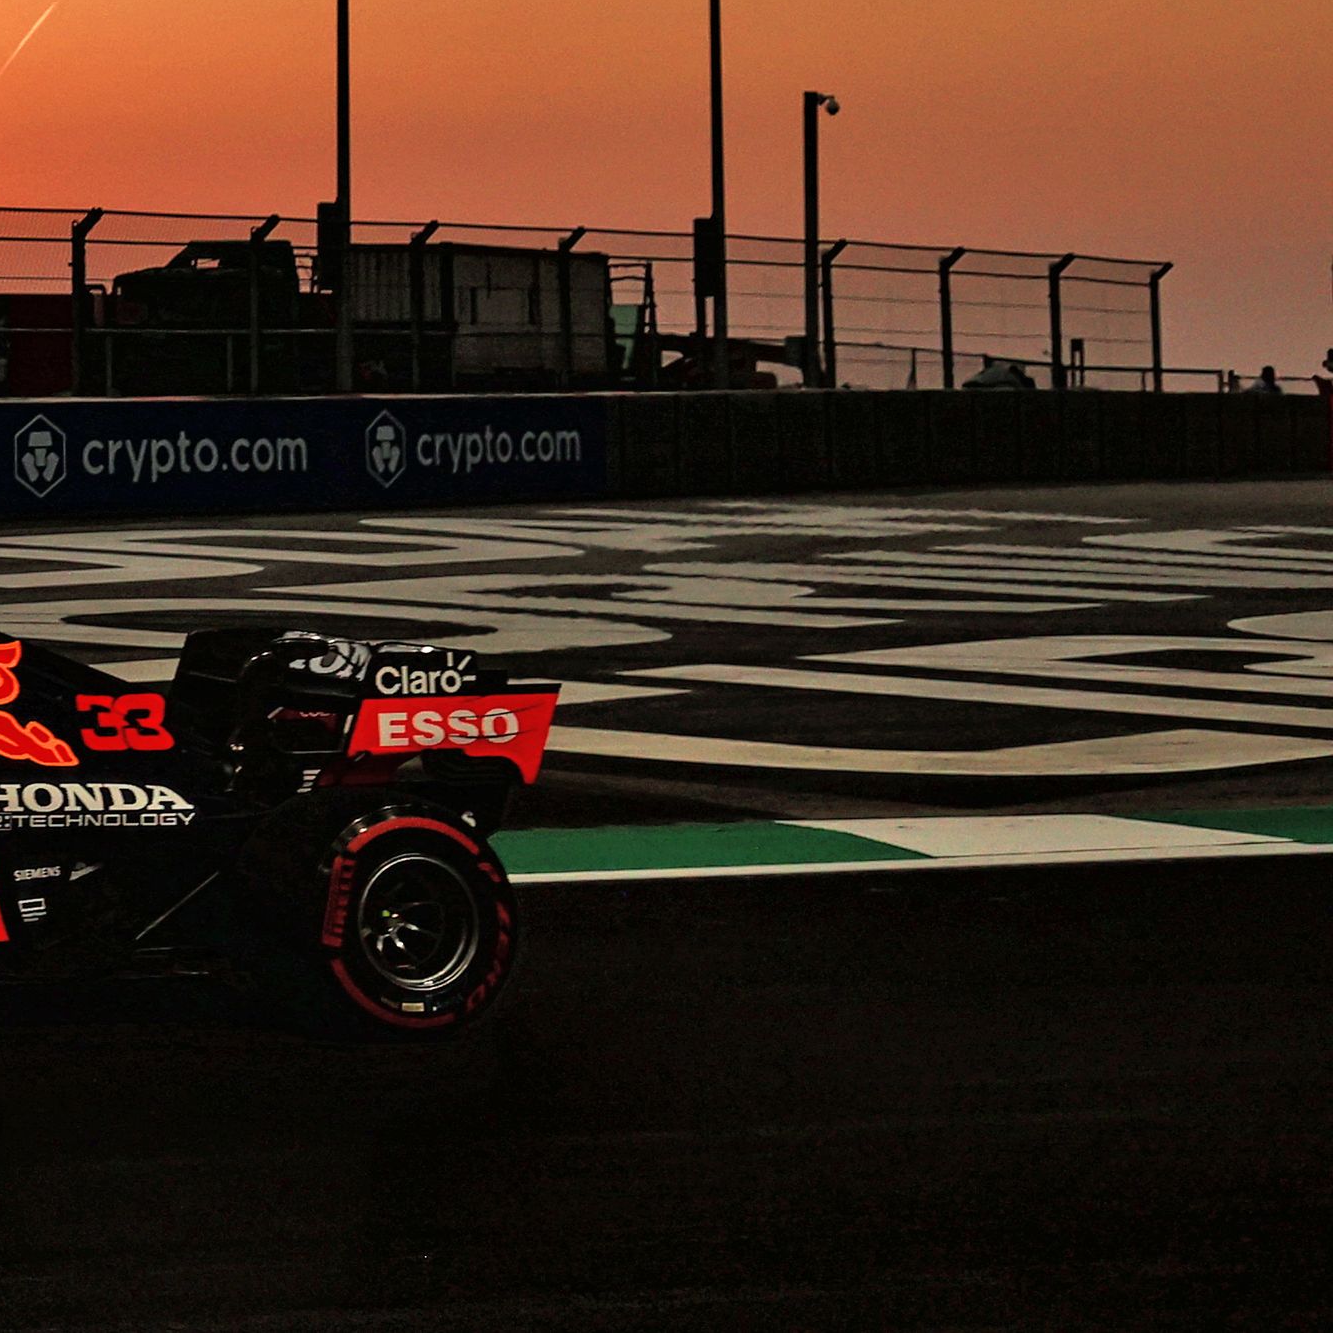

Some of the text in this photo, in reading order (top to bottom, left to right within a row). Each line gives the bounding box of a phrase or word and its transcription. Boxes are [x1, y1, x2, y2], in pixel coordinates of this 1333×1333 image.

[81, 430, 308, 483] crypto.com
[415, 424, 581, 474] crypto.com
[375, 662, 464, 696] Claro
[74, 692, 176, 751] 33
[377, 707, 520, 747] ESSO
